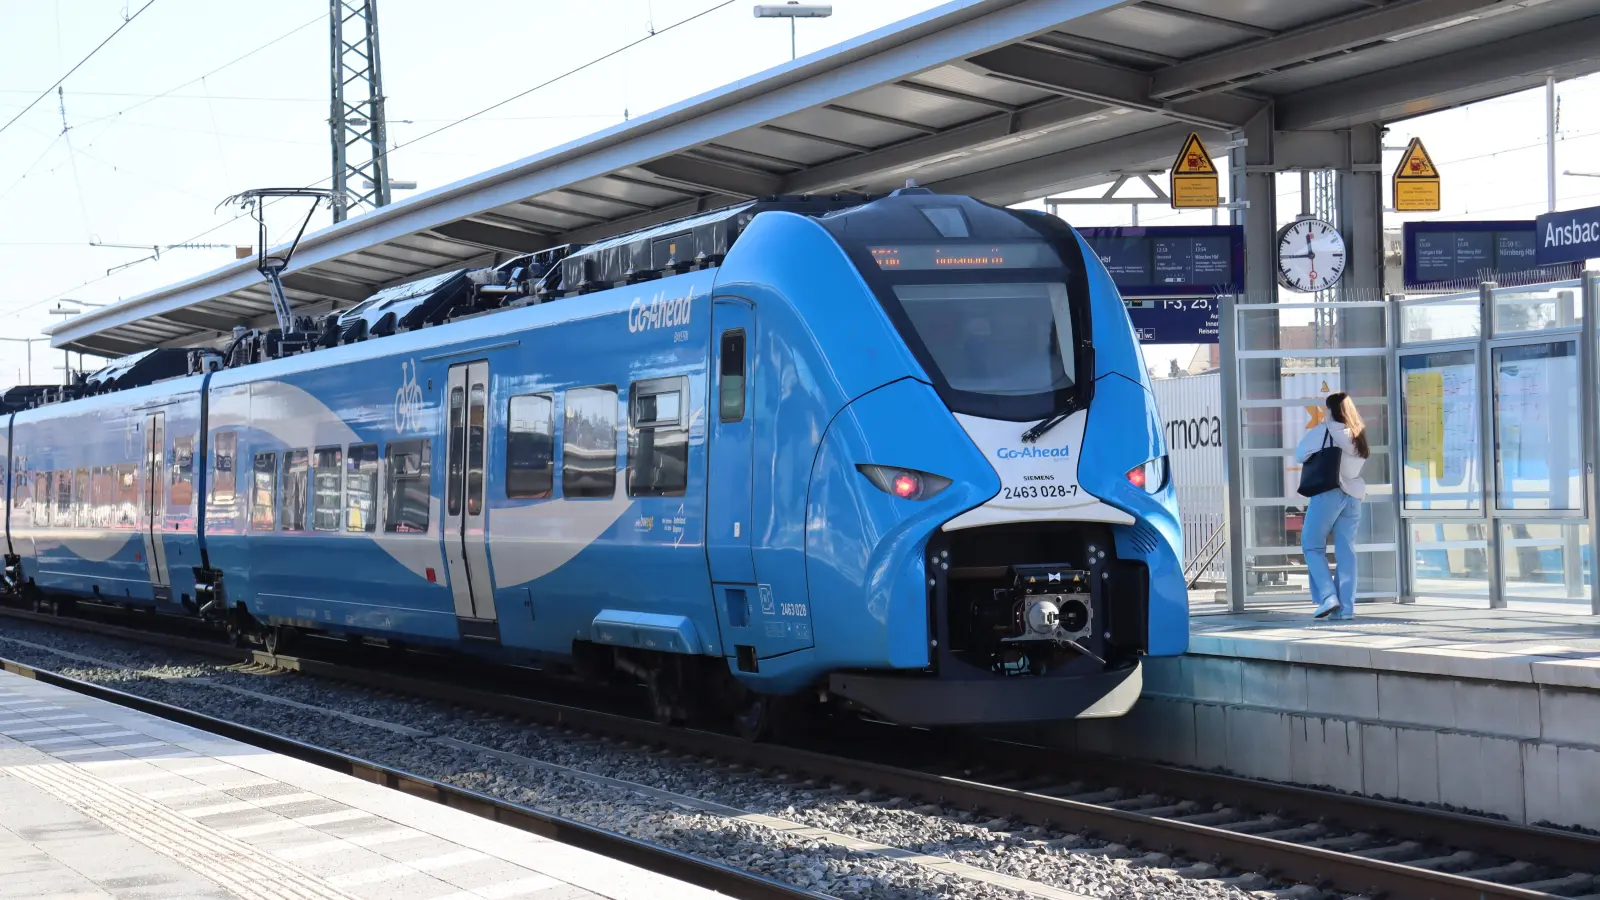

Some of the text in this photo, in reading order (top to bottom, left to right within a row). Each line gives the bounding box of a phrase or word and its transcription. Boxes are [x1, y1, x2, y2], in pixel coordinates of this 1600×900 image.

[996, 445, 1069, 459] Go-Ahead
[1003, 485, 1078, 500] 2463 028-7
[780, 603, 795, 616] 2463
